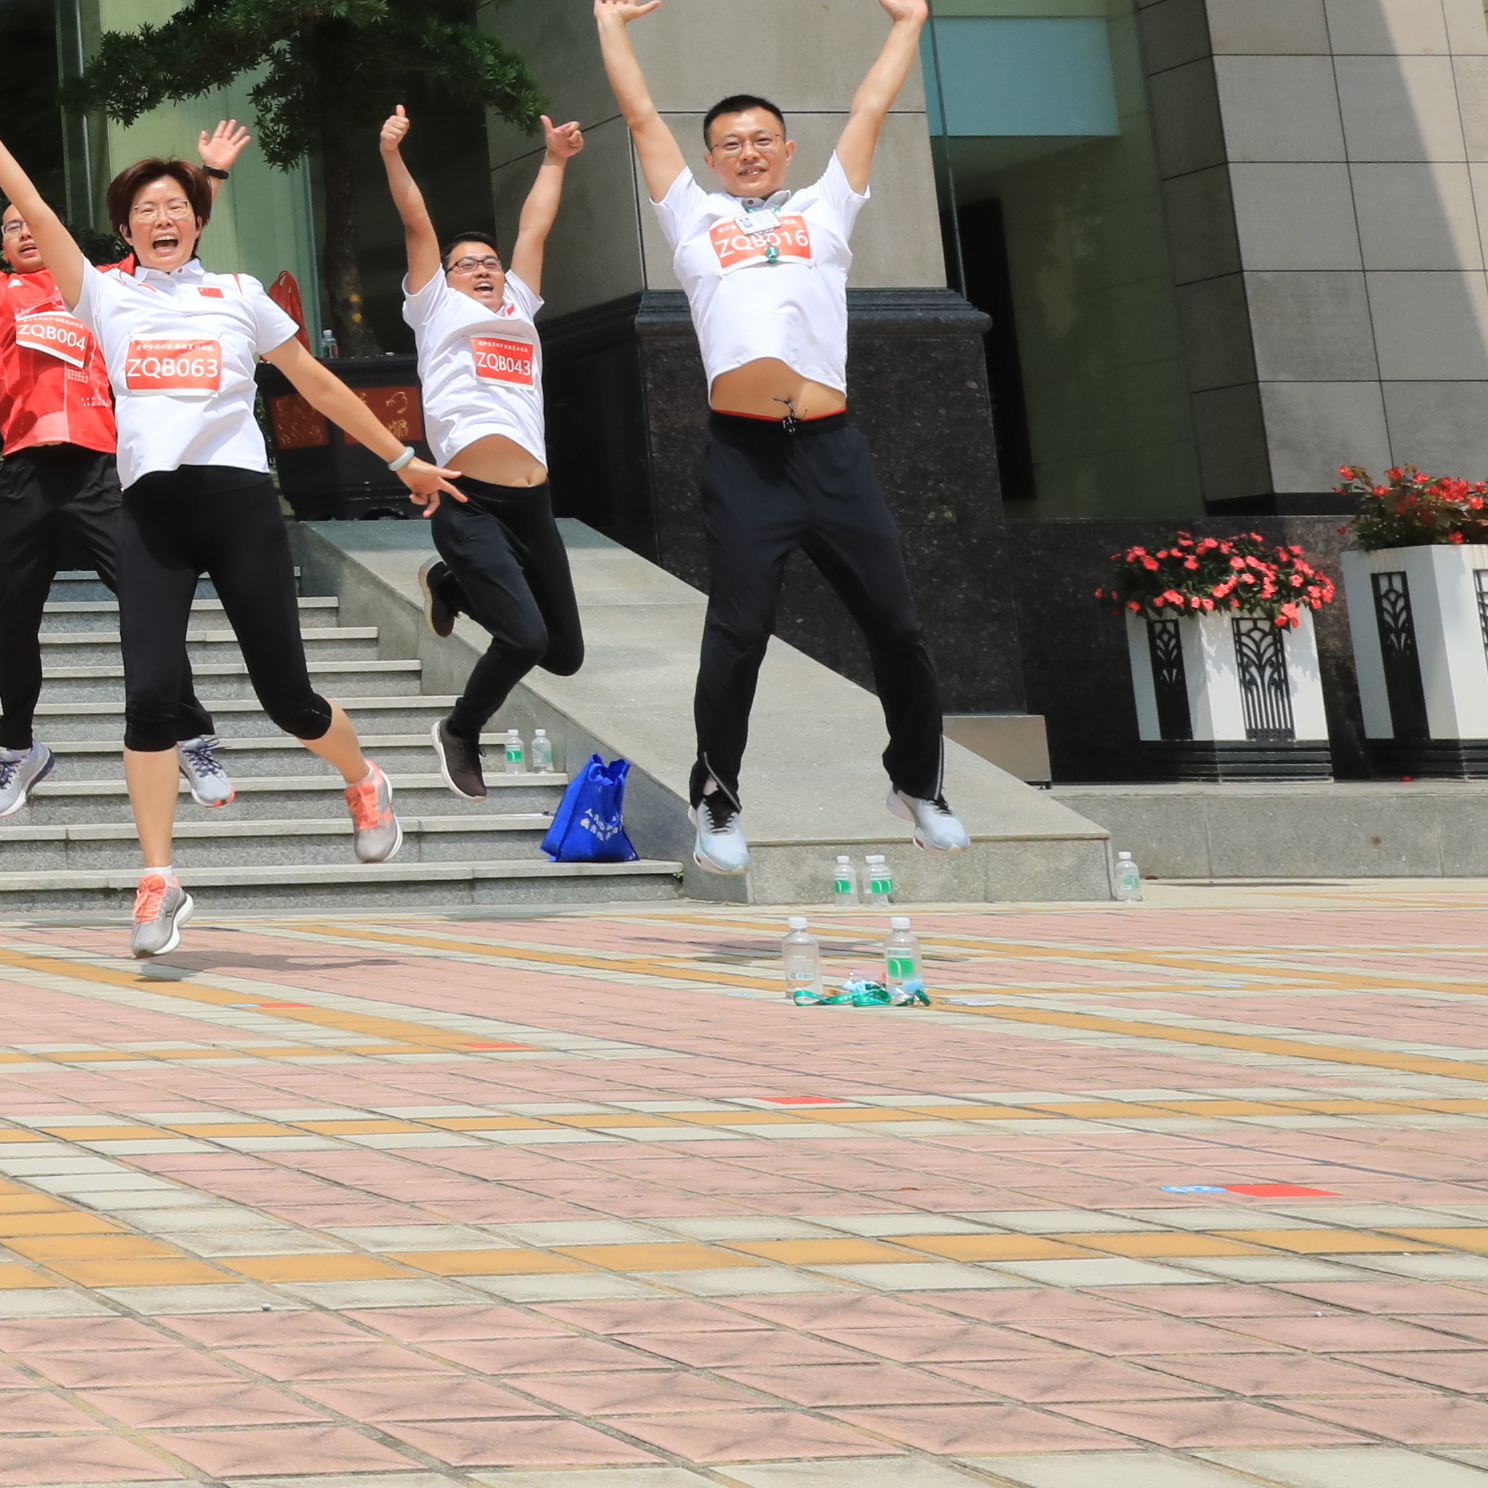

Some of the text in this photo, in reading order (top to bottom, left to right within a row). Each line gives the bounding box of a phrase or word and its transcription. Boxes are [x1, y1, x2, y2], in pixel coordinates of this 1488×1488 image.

[715, 229, 809, 258] ZQB016
[17, 324, 86, 352] ZQB004
[127, 357, 219, 379] ZQB063
[476, 352, 531, 375] ZQB043
